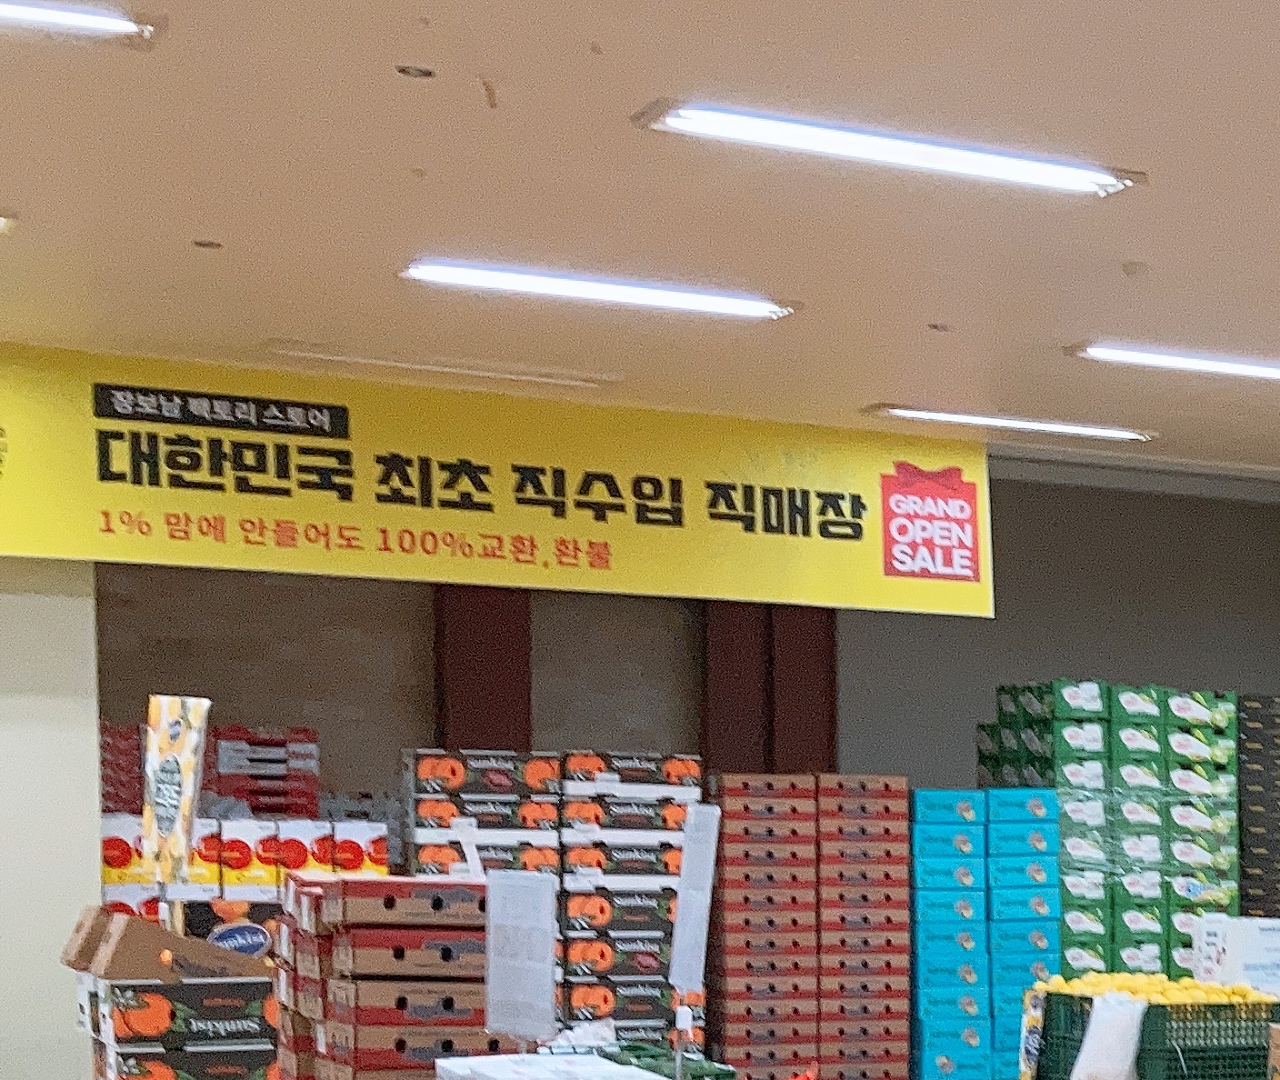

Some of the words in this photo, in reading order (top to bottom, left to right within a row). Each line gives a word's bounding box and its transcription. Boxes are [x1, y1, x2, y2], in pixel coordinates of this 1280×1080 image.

[111, 389, 182, 417] 장보남
[262, 402, 331, 431] 스토어
[96, 428, 354, 501] 대한민국
[374, 453, 494, 512] 최초
[511, 464, 684, 527] 직수입
[705, 480, 868, 541] 직매장
[888, 494, 972, 520] GRAND
[100, 510, 152, 536] 1%
[165, 512, 226, 543] 맘에
[240, 517, 365, 551] 안들어도
[889, 517, 972, 548] OPEN
[891, 545, 974, 575] SALE
[190, 1016, 261, 1037] Sunkist
